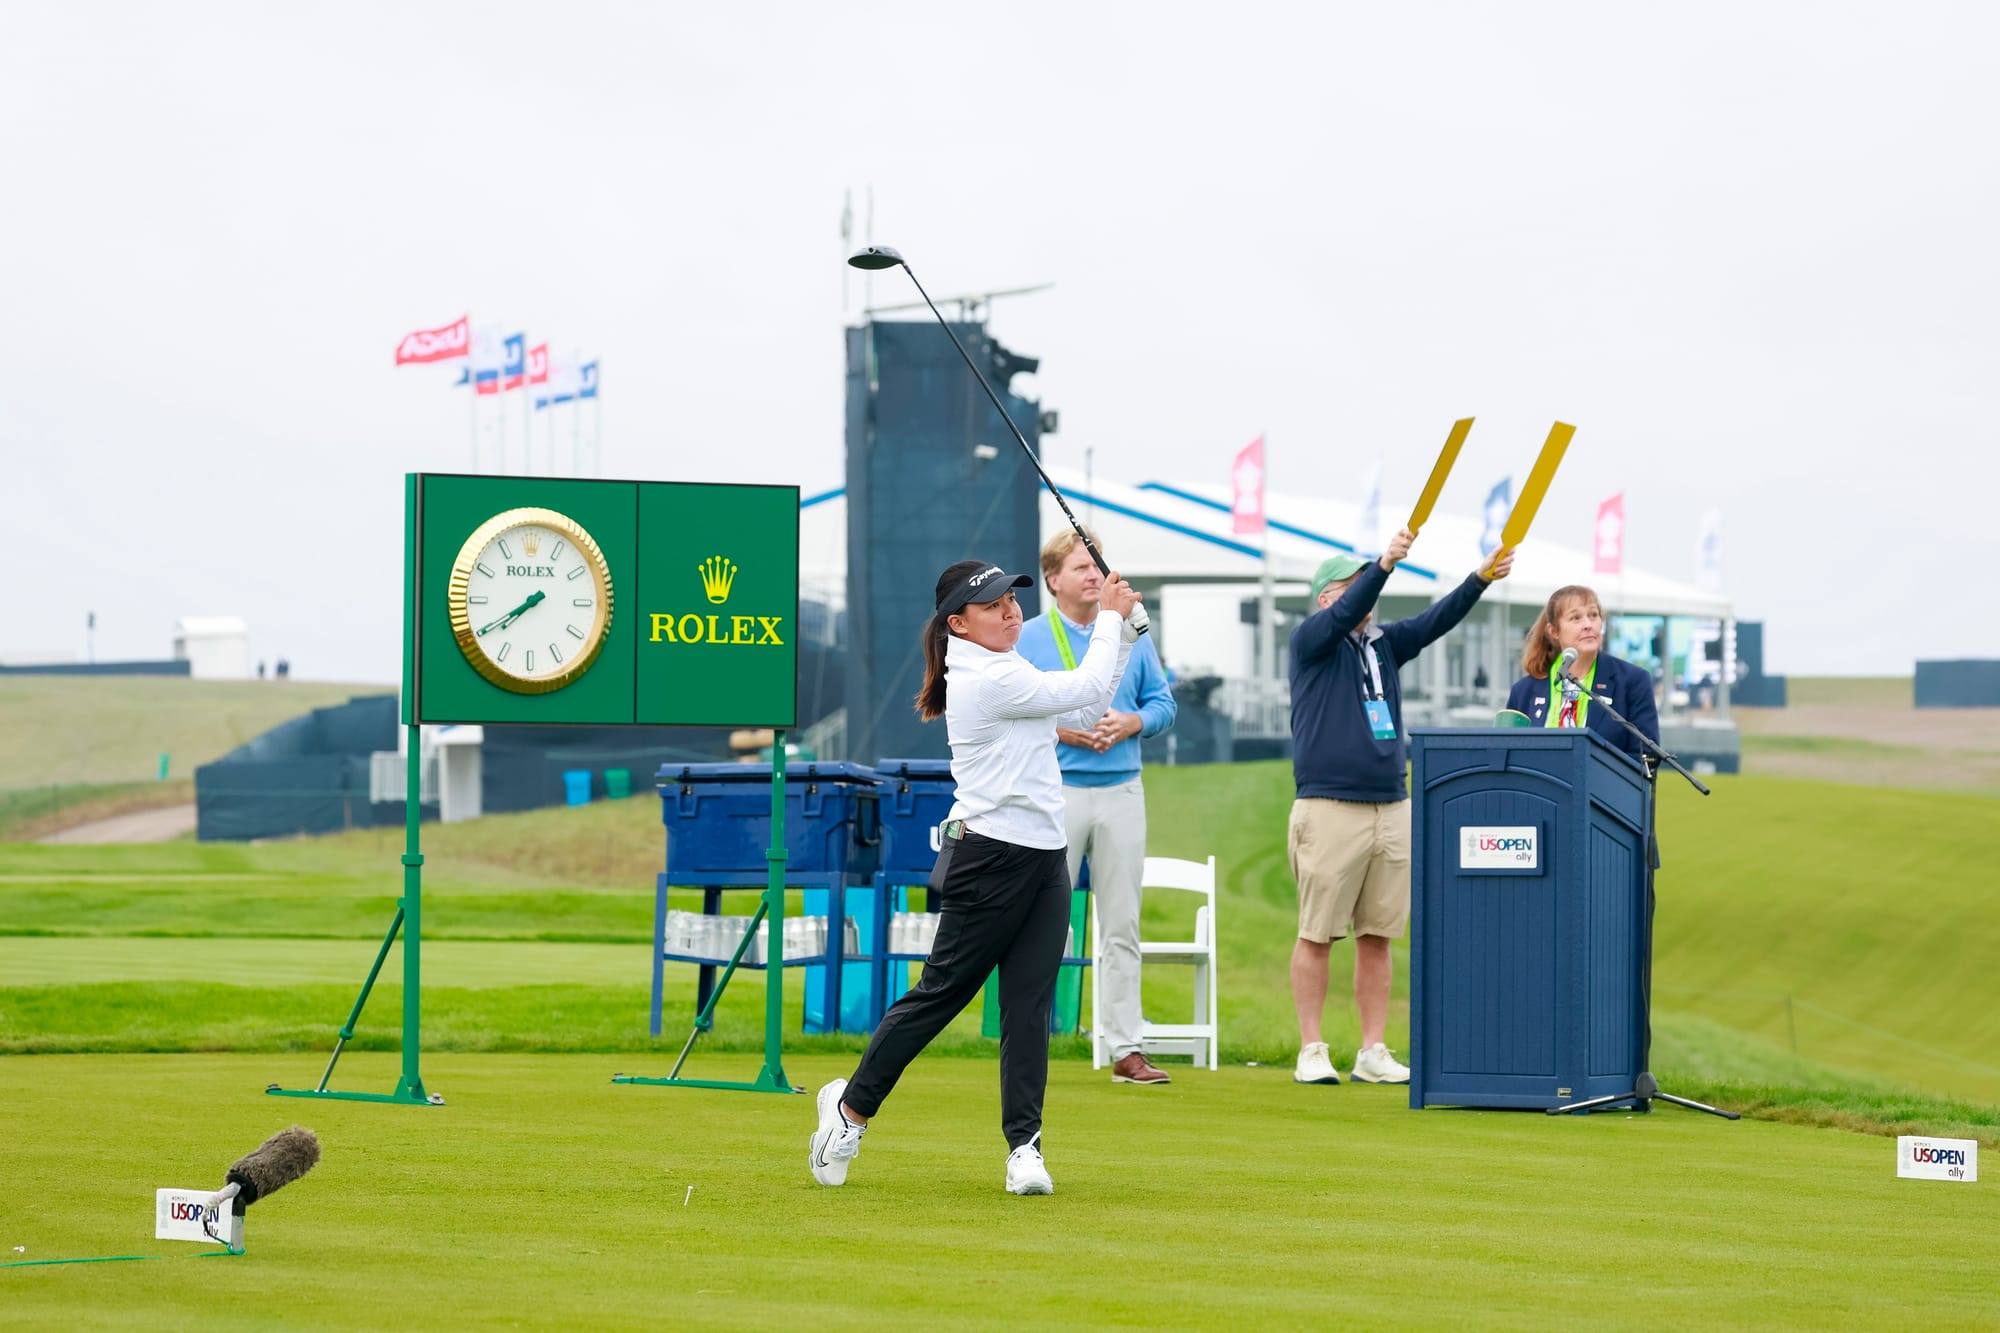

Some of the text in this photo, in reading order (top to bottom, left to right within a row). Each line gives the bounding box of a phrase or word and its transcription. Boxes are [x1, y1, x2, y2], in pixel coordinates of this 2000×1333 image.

[506, 564, 555, 578] ROLEX
[649, 613, 784, 646] ROLEX
[1515, 852, 1532, 863] ally
[1948, 1167, 1965, 1180] ally
[171, 1202, 219, 1223] USOPN
